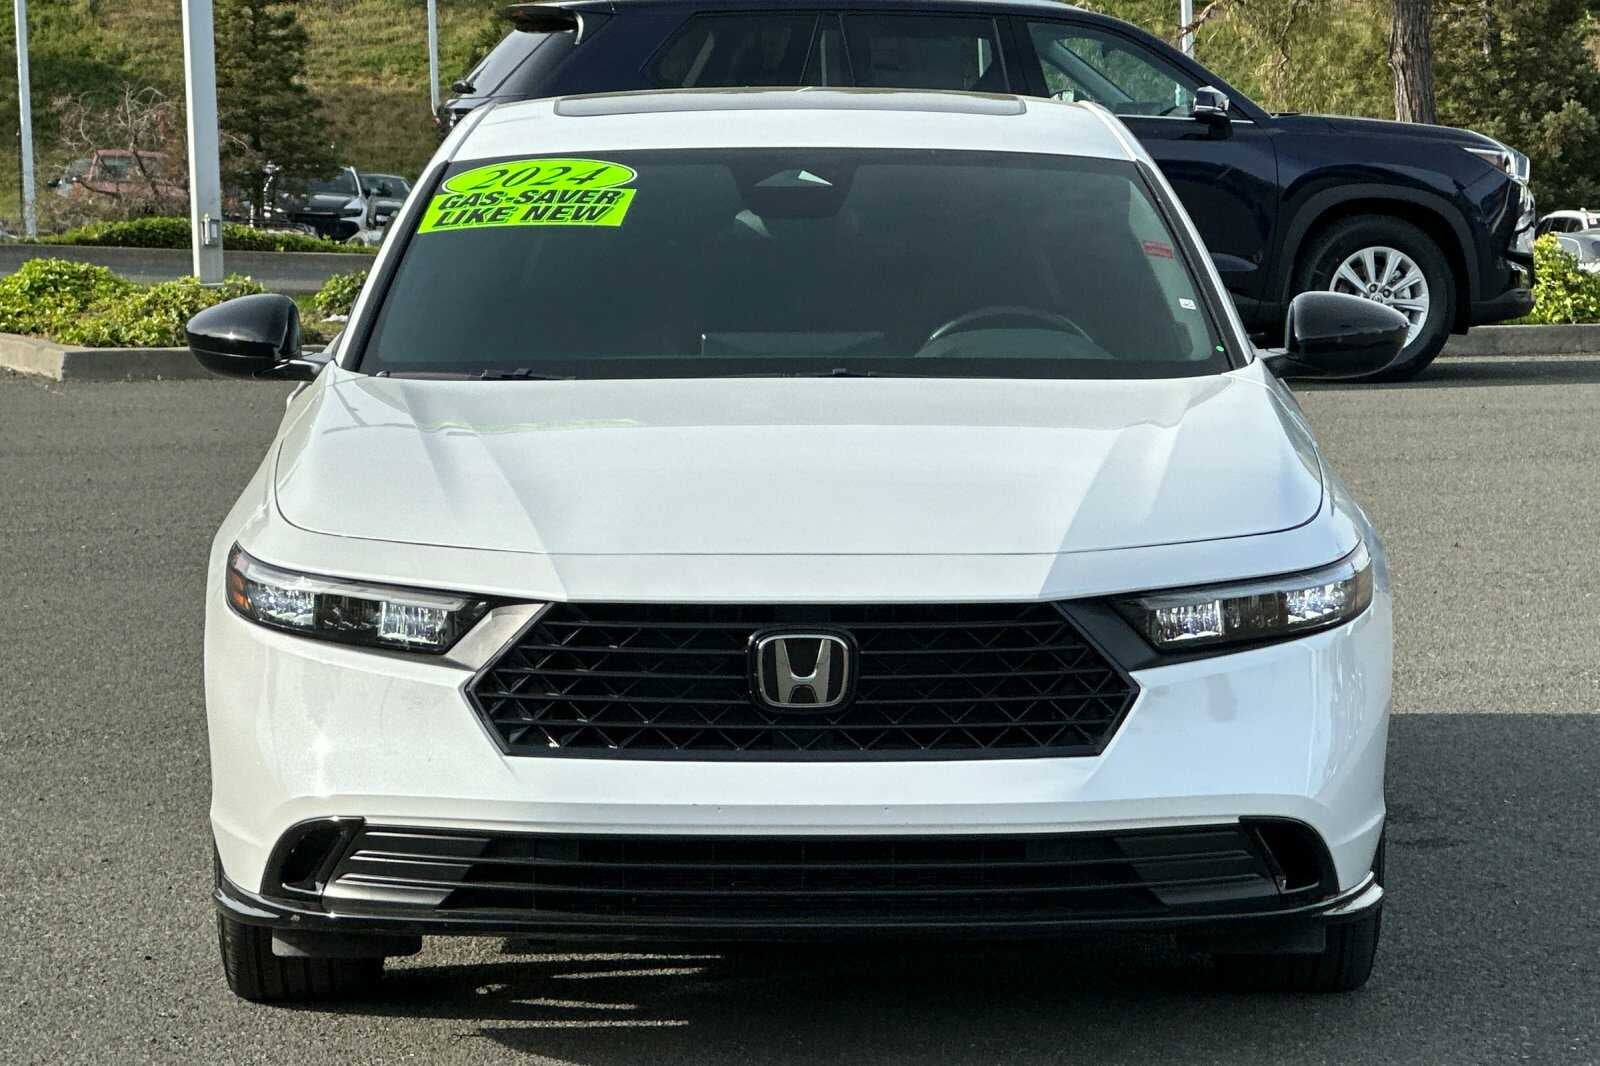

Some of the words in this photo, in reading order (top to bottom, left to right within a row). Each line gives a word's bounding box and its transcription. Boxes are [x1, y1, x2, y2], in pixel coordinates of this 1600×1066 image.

[466, 166, 609, 190] 2024
[438, 189, 624, 210] GAS-SAVER
[432, 206, 518, 227] LIKE
[520, 205, 614, 223] NEW
